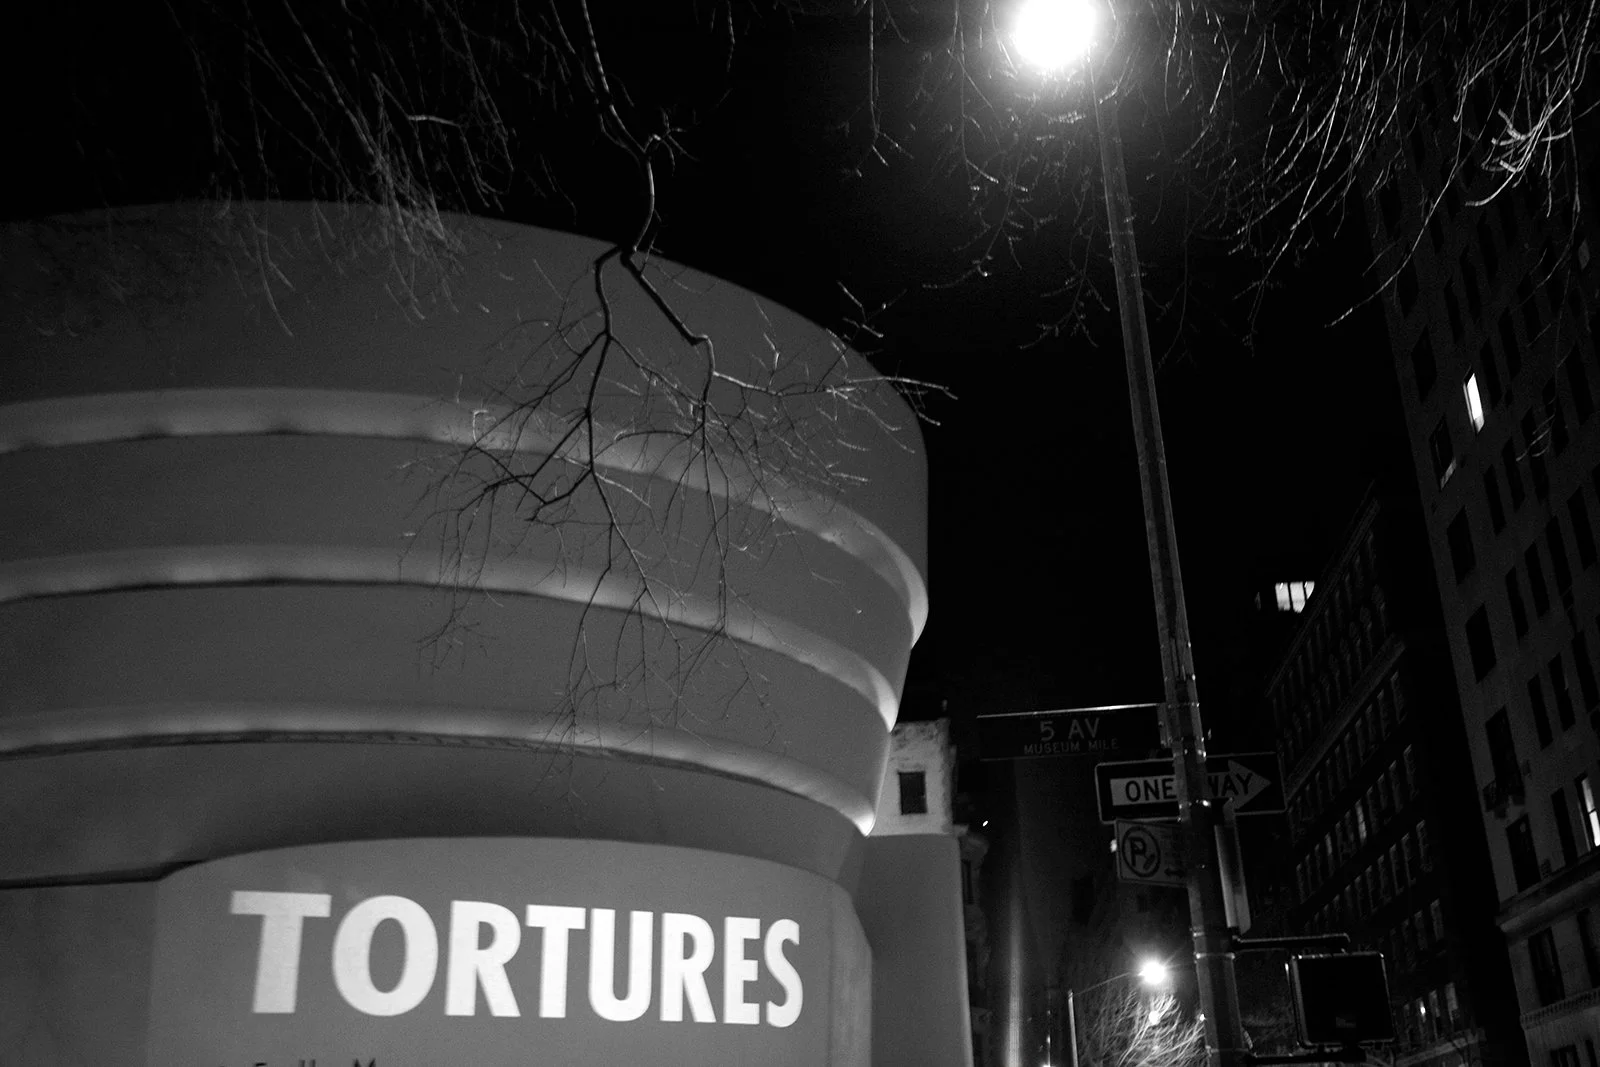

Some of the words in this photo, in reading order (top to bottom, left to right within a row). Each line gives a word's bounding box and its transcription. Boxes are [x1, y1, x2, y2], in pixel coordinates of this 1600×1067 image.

[1040, 720, 1055, 741] 5
[1068, 718, 1101, 740] AV
[1023, 741, 1081, 755] MUSEUM
[1088, 737, 1118, 751] MILE
[1125, 778, 1177, 802] ONE
[230, 890, 803, 1028] TORTURES
